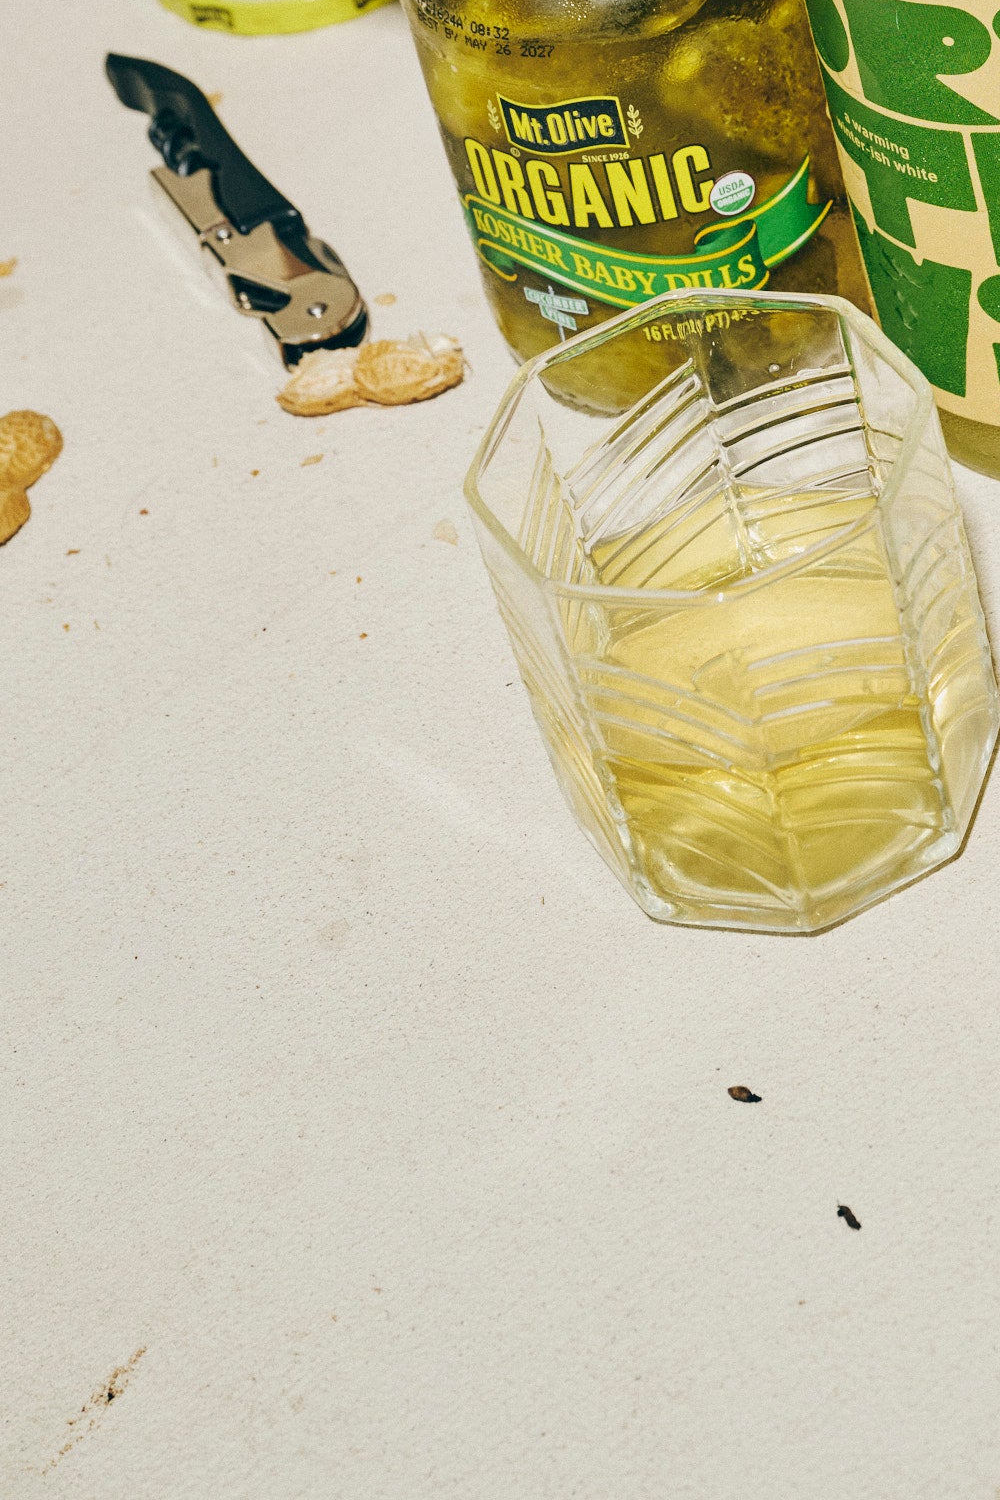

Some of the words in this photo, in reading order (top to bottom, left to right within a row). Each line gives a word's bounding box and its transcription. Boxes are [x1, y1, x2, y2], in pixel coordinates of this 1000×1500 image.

[418, 8, 438, 32] BEST
[465, 35, 487, 51] MAY
[496, 43, 511, 56] 26
[520, 44, 555, 58] 2027
[470, 21, 510, 41] 08:32
[609, 152, 630, 163] 1926
[835, 115, 891, 168] winter-ish
[893, 160, 938, 183] white
[843, 112, 851, 125] a
[852, 118, 910, 161] warming
[464, 137, 716, 229] ORGANIC
[718, 179, 745, 196] USDA
[473, 208, 571, 272] KOSHER
[570, 250, 659, 296] BABY
[664, 253, 757, 293] DILLS
